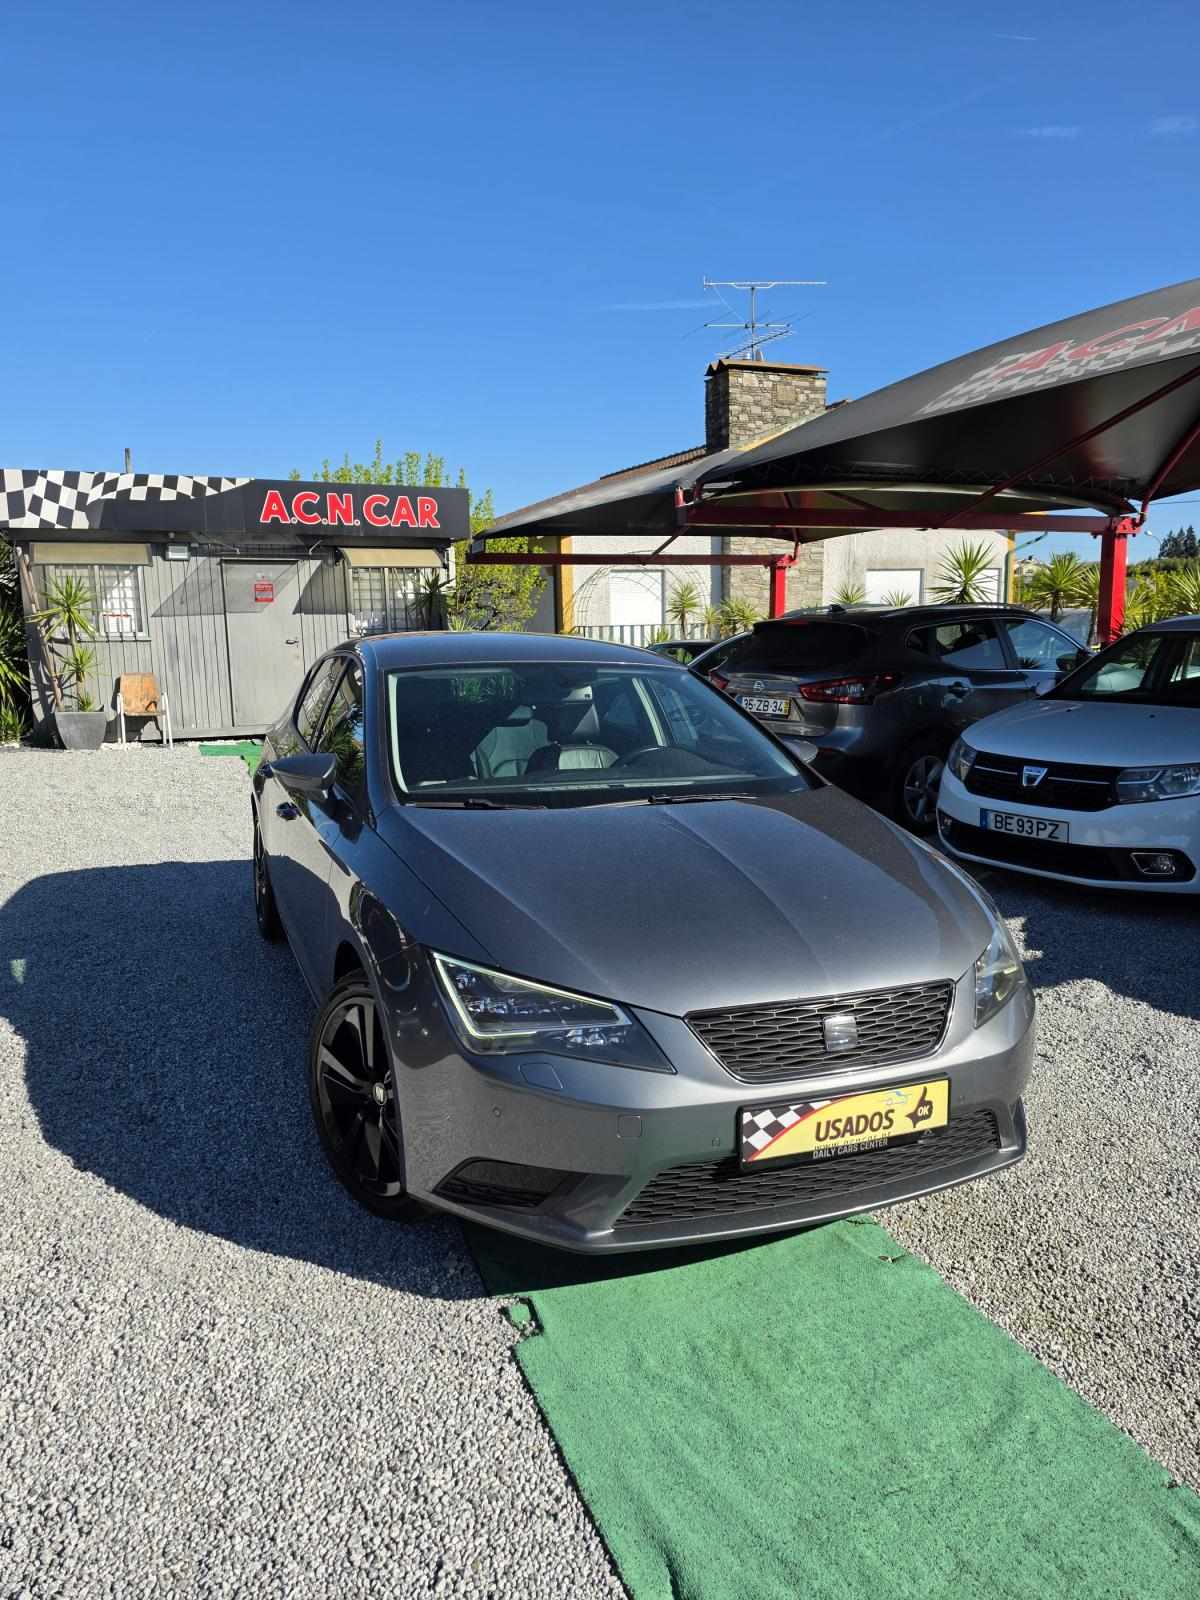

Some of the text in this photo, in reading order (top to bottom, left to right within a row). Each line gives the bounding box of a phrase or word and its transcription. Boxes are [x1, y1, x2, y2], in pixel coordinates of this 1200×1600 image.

[917, 1104, 930, 1117] OK
[815, 1109, 895, 1142] USADOS
[812, 1146, 837, 1159] DAILY
[837, 1143, 858, 1156] CARS
[859, 1137, 889, 1151] CENTER
